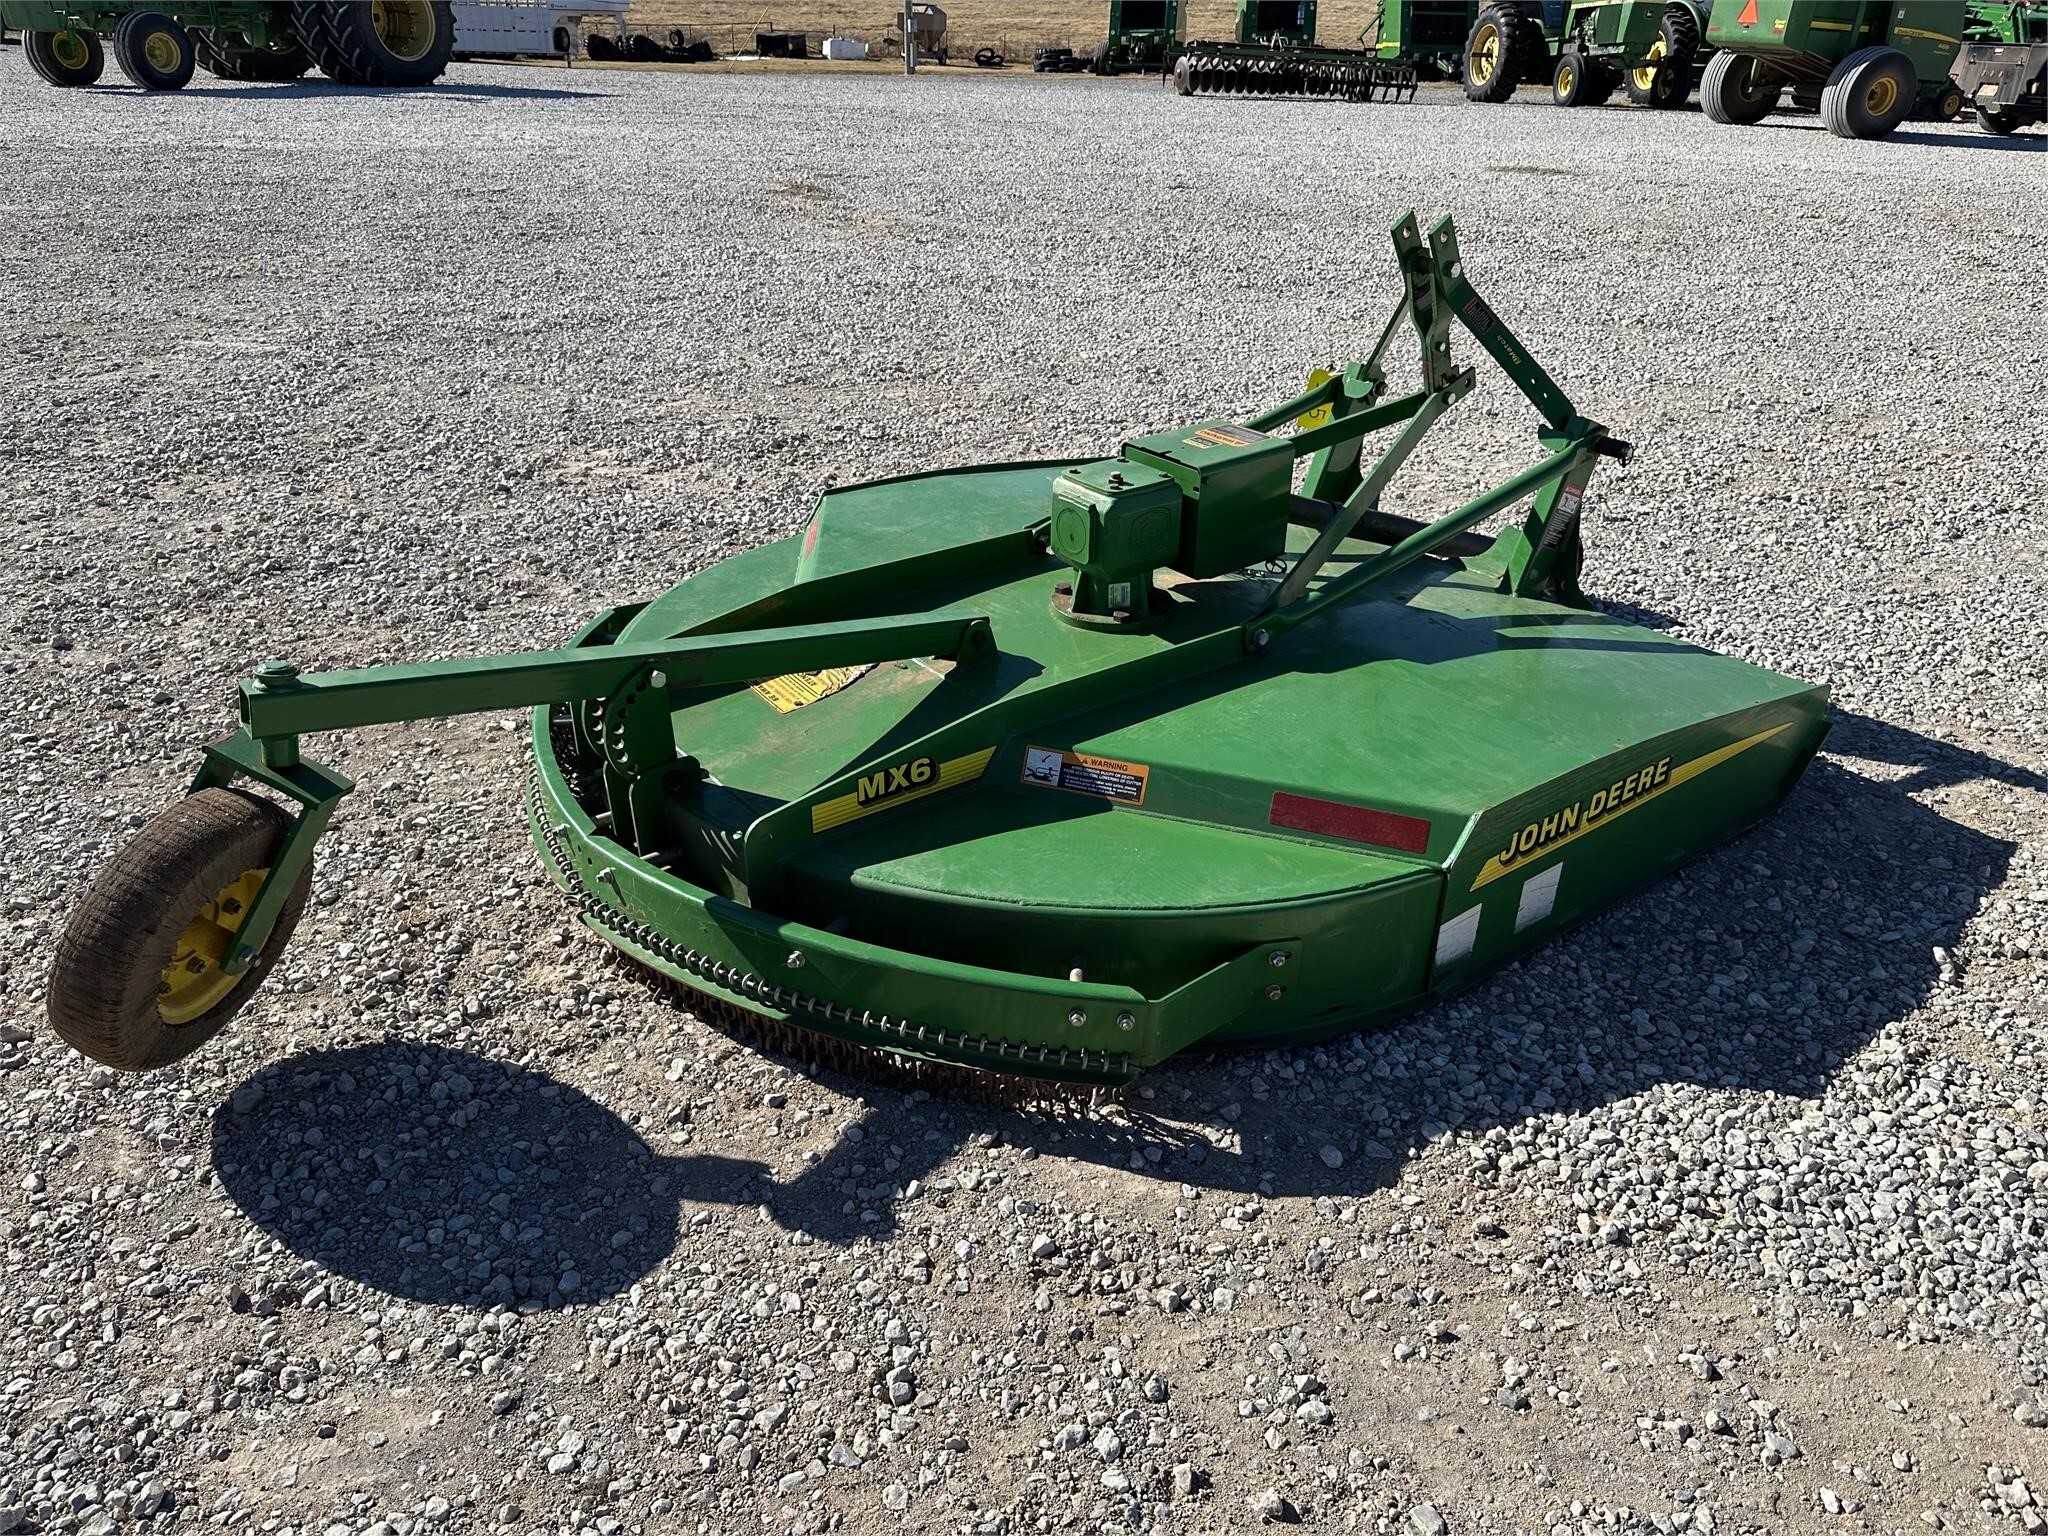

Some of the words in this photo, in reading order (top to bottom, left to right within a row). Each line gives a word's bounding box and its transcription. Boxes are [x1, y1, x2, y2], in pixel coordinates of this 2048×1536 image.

[857, 757, 933, 804] MX6
[1091, 758, 1128, 772] WARNING
[1500, 803, 1580, 862] JOHN
[1587, 756, 1672, 818] DEERE
